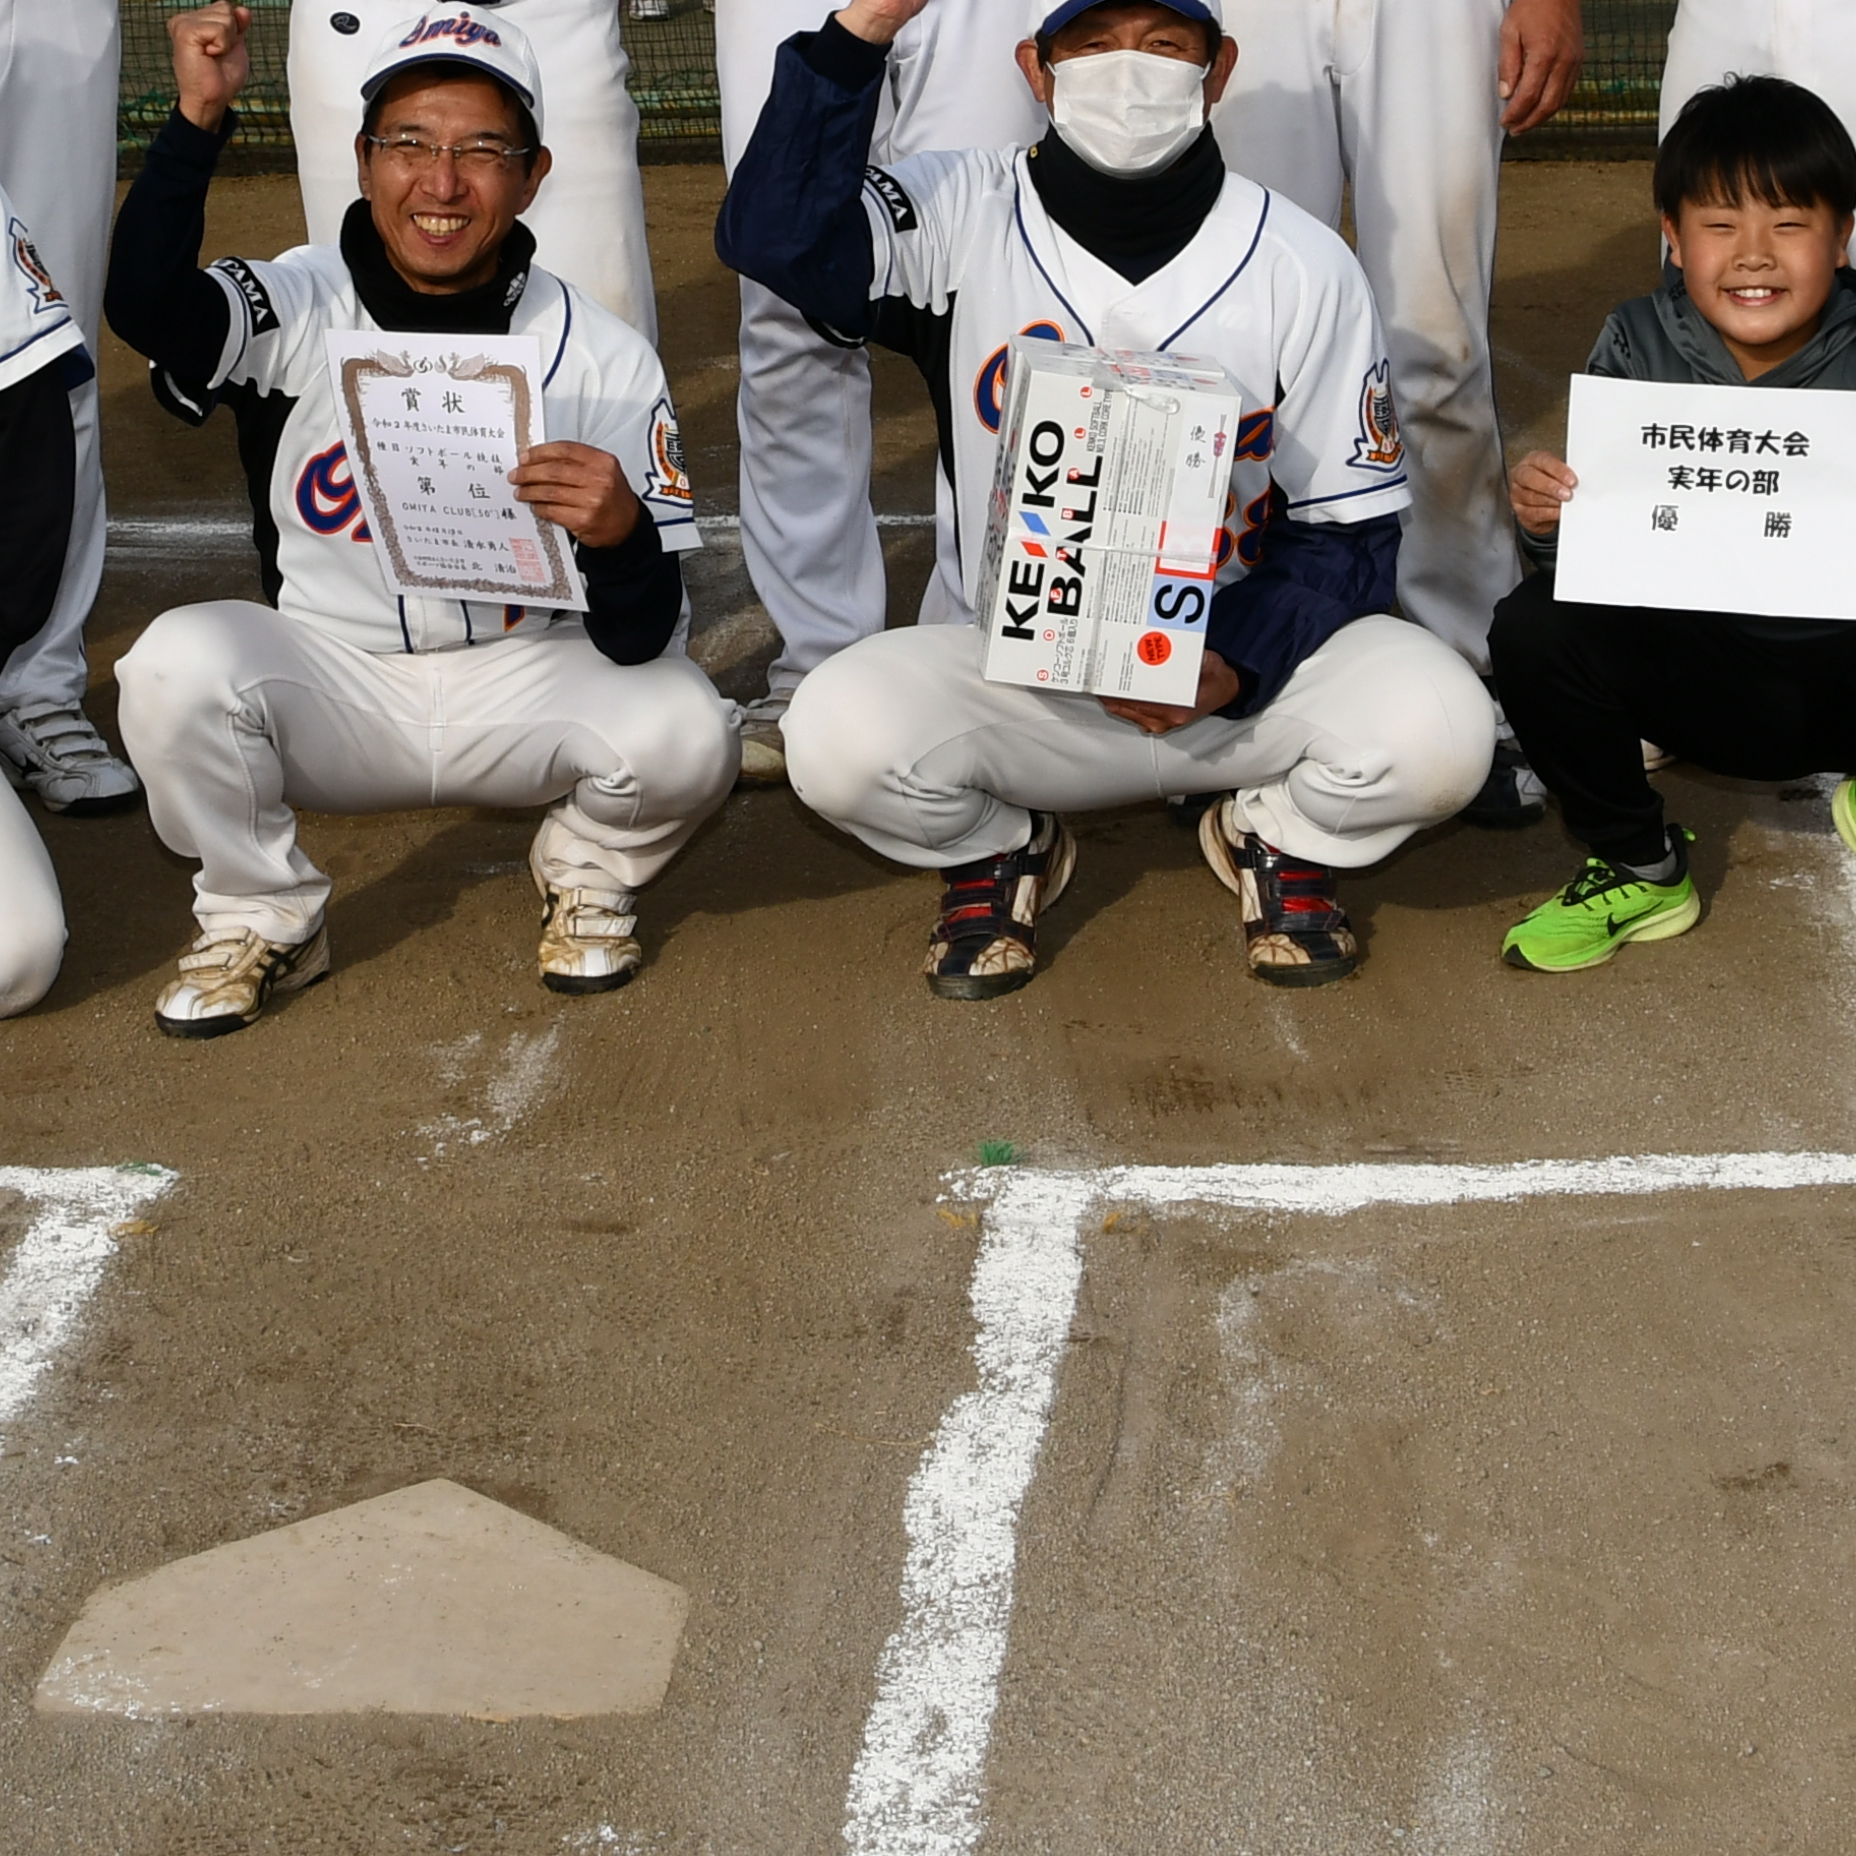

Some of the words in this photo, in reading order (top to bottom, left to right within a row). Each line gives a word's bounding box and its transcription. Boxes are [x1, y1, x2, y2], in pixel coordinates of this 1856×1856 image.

[1641, 423, 1810, 457] 市民体育大会
[1667, 465, 1780, 495] 実年の部
[1651, 505, 1679, 532] 優
[1764, 511, 1792, 538] 勝
[1154, 584, 1206, 624] S
